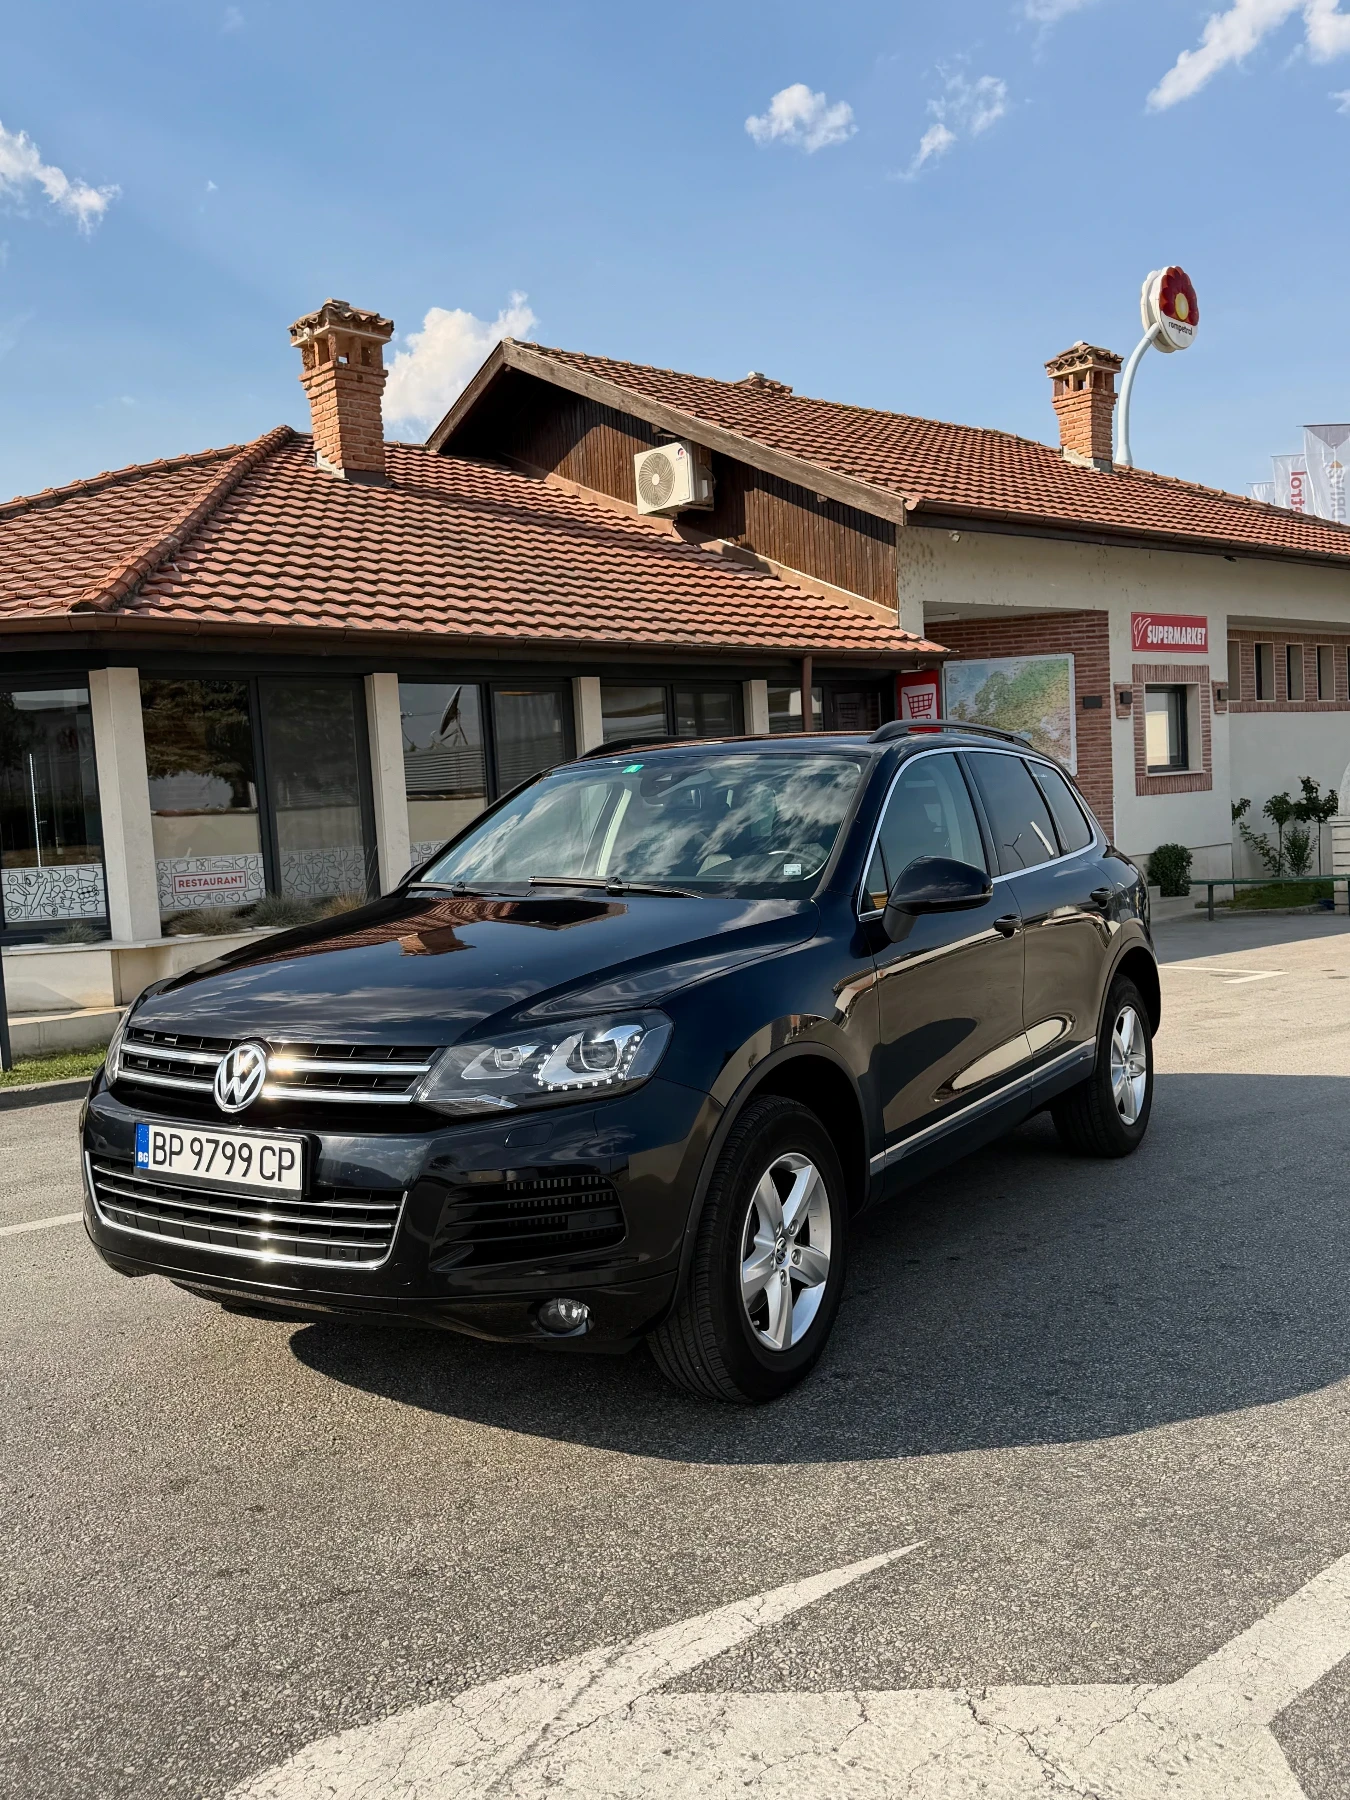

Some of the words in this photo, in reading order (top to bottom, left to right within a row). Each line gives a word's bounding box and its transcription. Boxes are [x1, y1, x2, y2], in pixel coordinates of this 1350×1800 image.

[1168, 321, 1193, 336] rompetrol
[1147, 625, 1206, 646] SUPERMARKET
[178, 876, 243, 888] RESTAURANT
[216, 1045, 264, 1110] VW
[138, 1151, 149, 1163] BG
[153, 1131, 184, 1168] BP
[190, 1137, 253, 1178] 9799
[259, 1145, 295, 1182] CP
